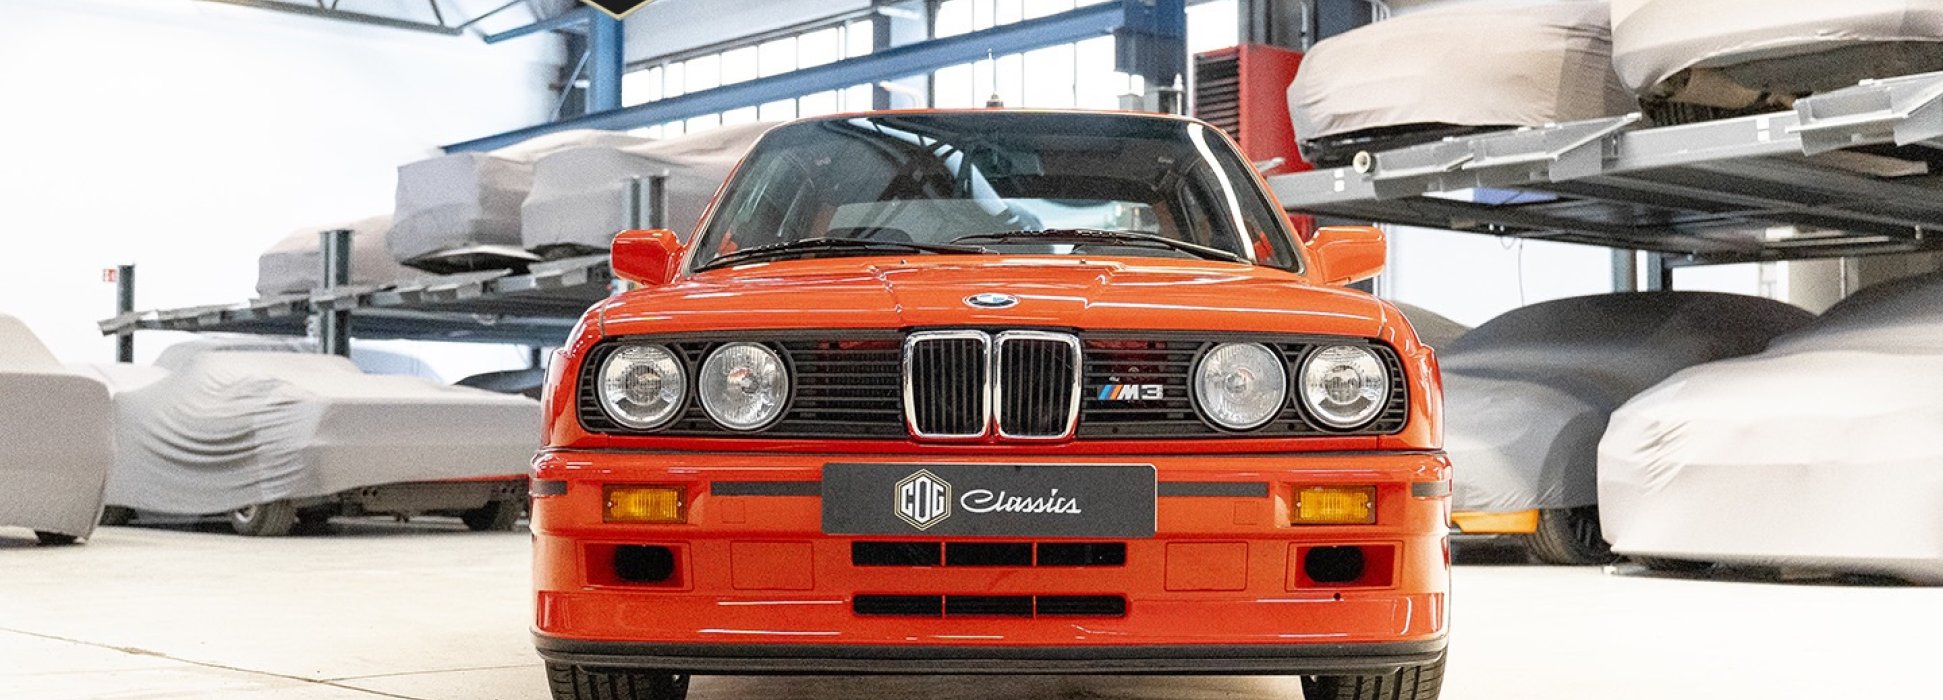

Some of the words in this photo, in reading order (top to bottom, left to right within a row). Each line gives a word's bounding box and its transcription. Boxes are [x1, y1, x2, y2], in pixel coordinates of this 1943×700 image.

[1116, 384, 1164, 400] M3
[901, 476, 946, 524] COG
[960, 488, 1082, 514] Classics
